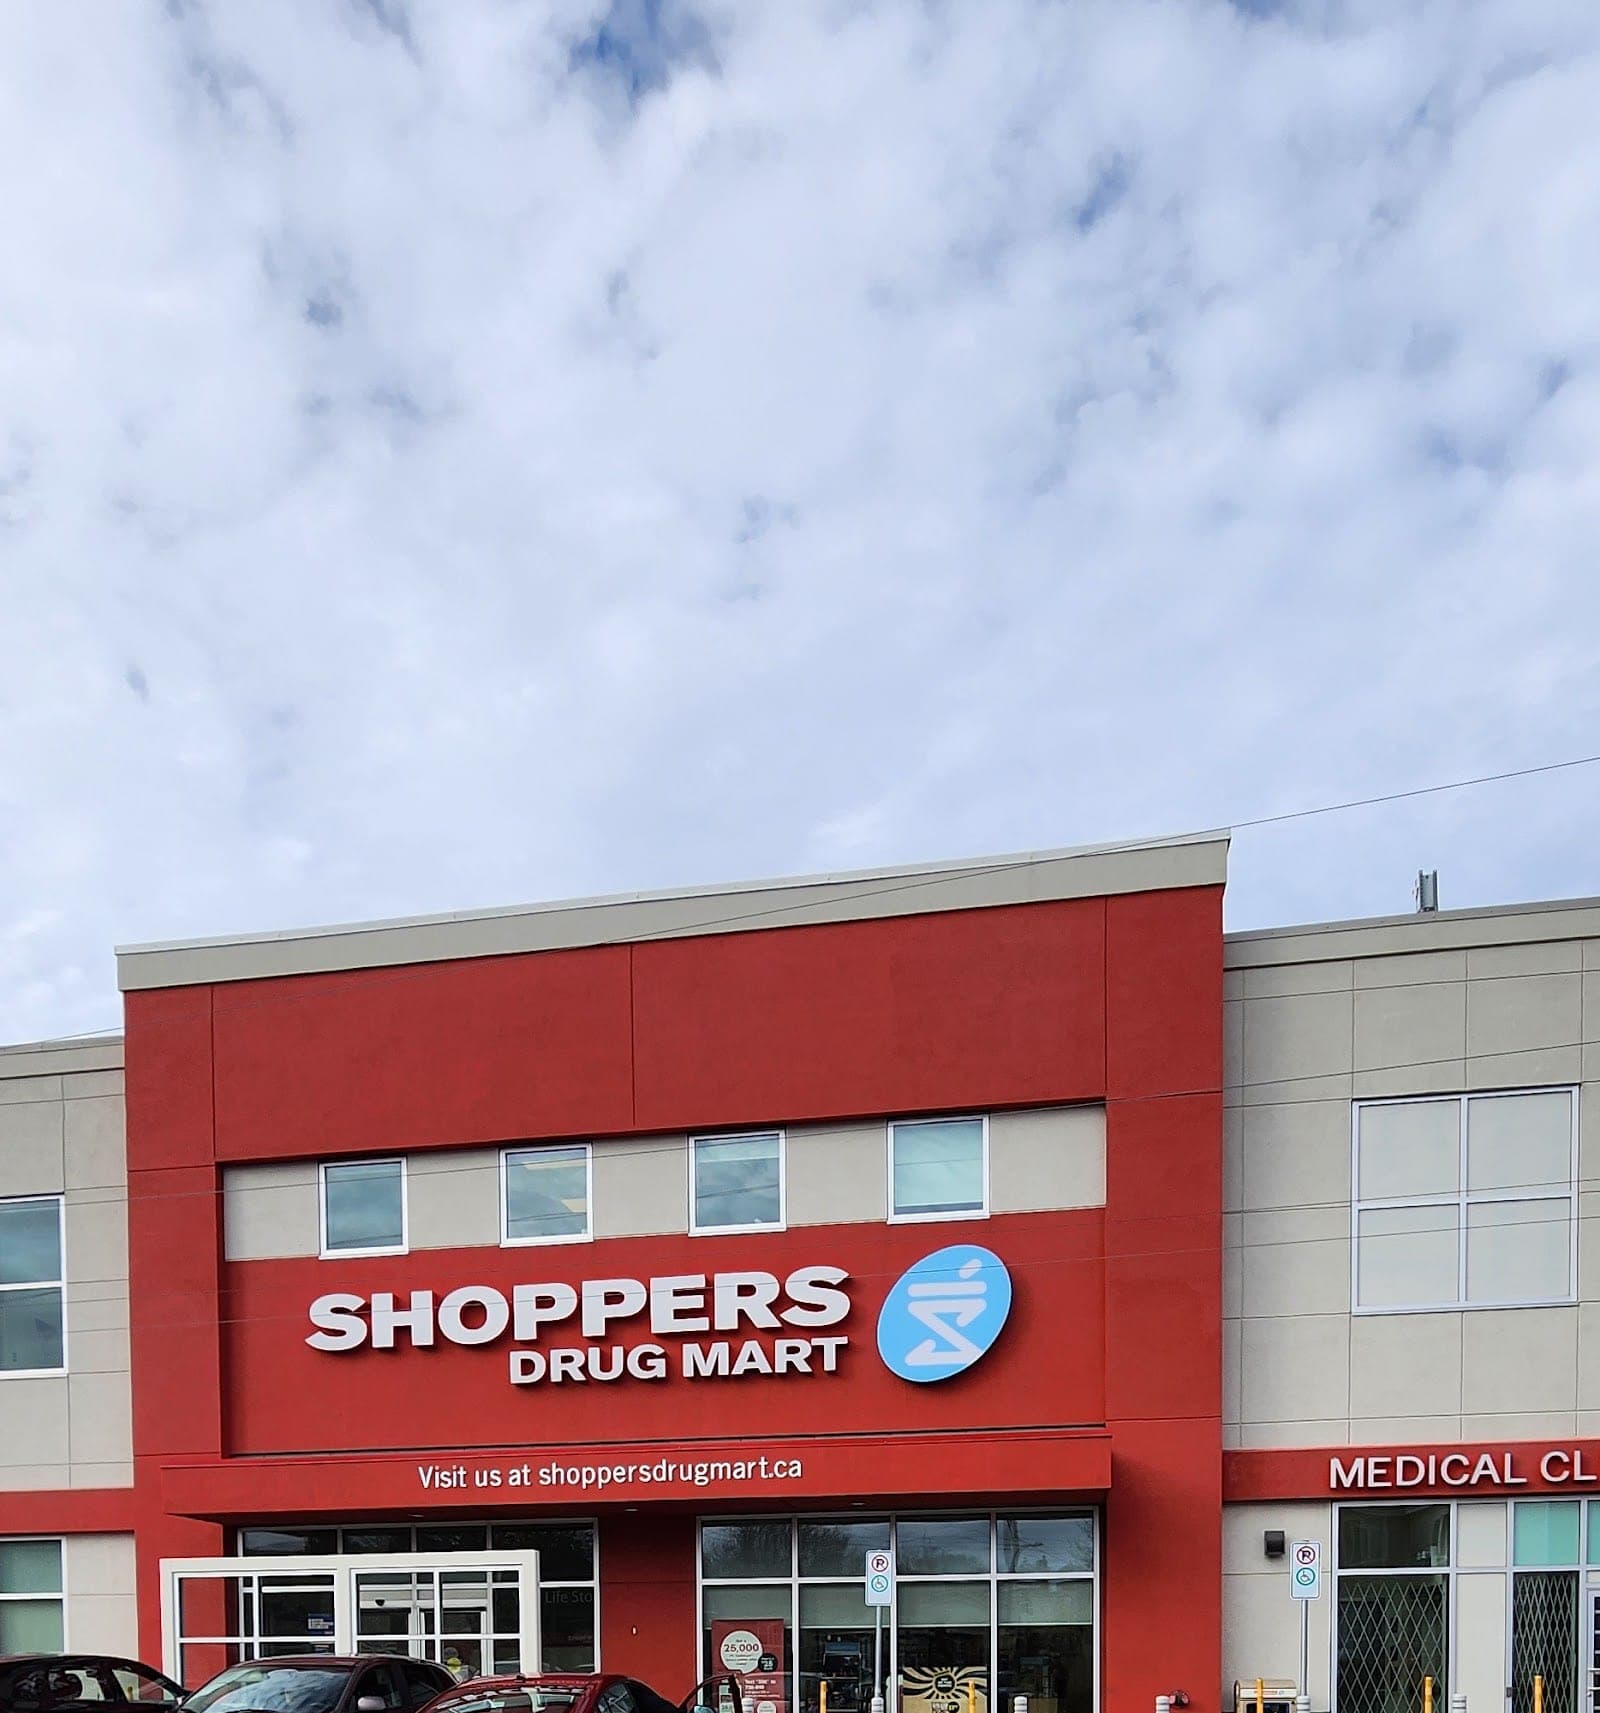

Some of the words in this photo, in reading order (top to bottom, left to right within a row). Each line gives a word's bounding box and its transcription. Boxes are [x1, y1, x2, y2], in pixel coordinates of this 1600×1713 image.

[305, 1266, 851, 1351] SHOPPERS
[510, 1345, 667, 1384] DRUG
[682, 1336, 849, 1378] MART
[418, 1465, 467, 1489] Visit
[475, 1469, 502, 1487] us
[508, 1465, 532, 1487] at
[539, 1456, 802, 1490] shoppersdrugmart.ca
[1330, 1452, 1527, 1489] MEDICAL
[1540, 1450, 1597, 1482] CL
[723, 1643, 759, 1653] 25,000
